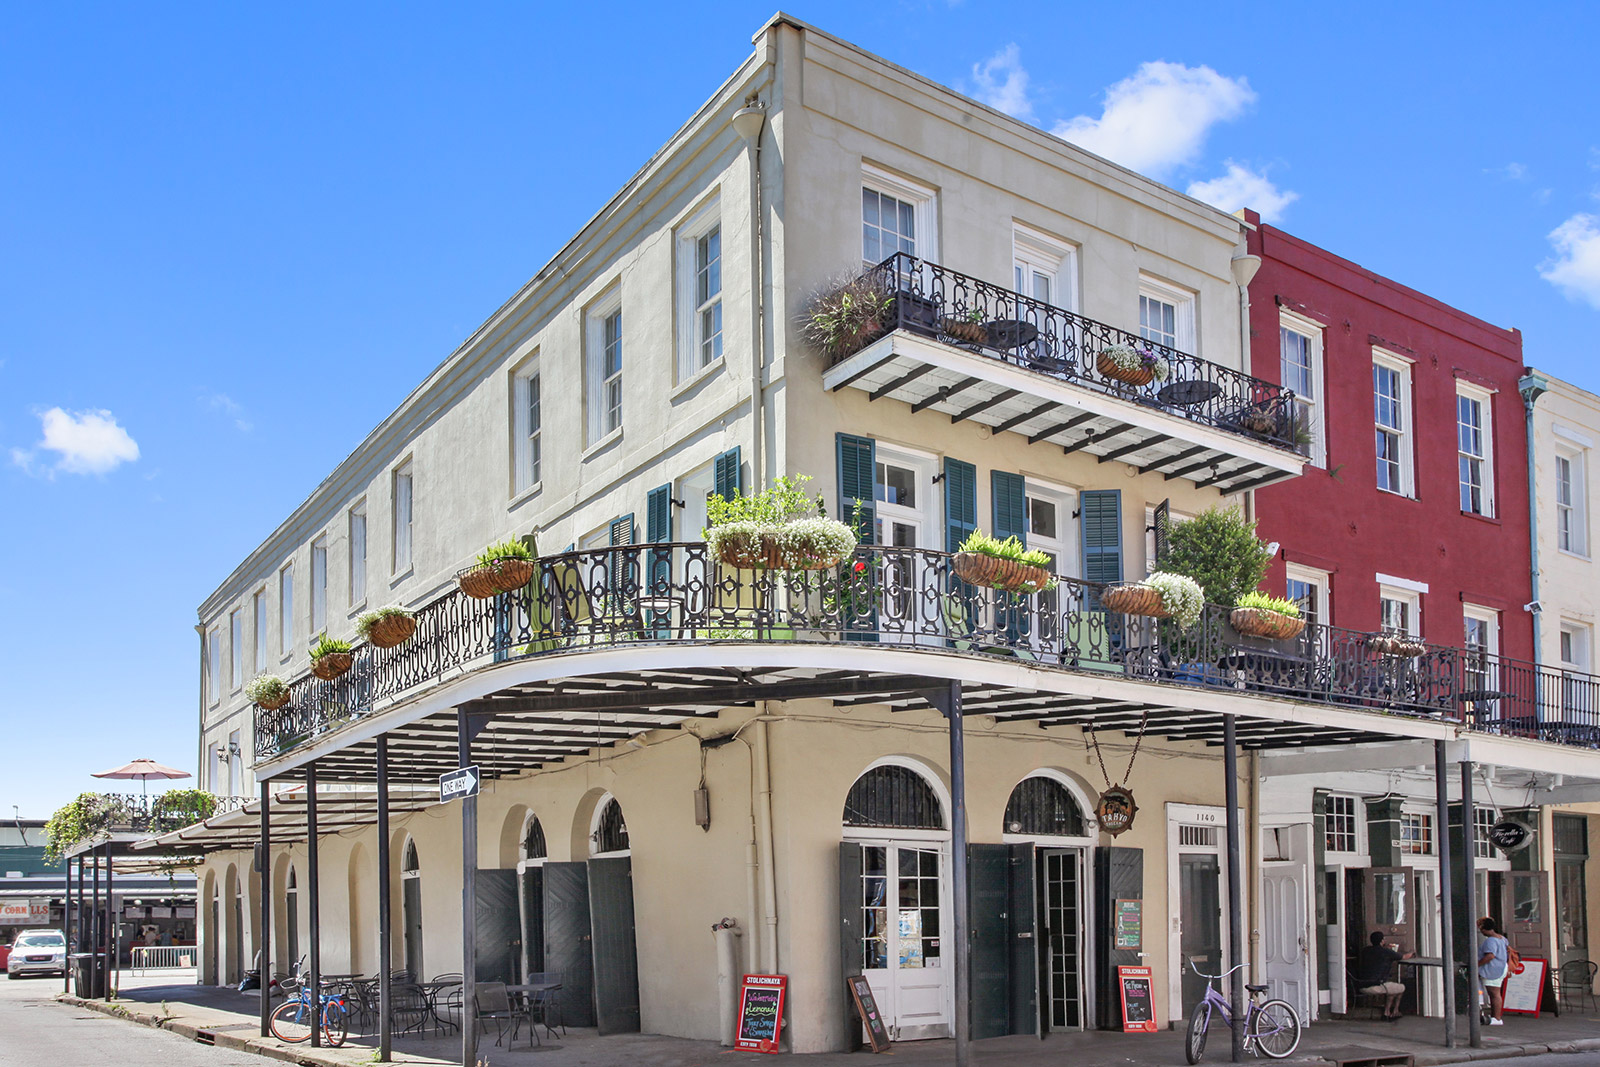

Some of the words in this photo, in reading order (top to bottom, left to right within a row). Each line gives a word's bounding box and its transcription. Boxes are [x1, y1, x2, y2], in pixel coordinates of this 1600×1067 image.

[443, 781, 454, 794] ONE
[455, 778, 466, 791] WAY
[1102, 813, 1128, 822] TAHYO
[1196, 813, 1215, 822] 1140
[5, 906, 28, 915] CORN
[746, 976, 781, 985] STOLICHNAYA
